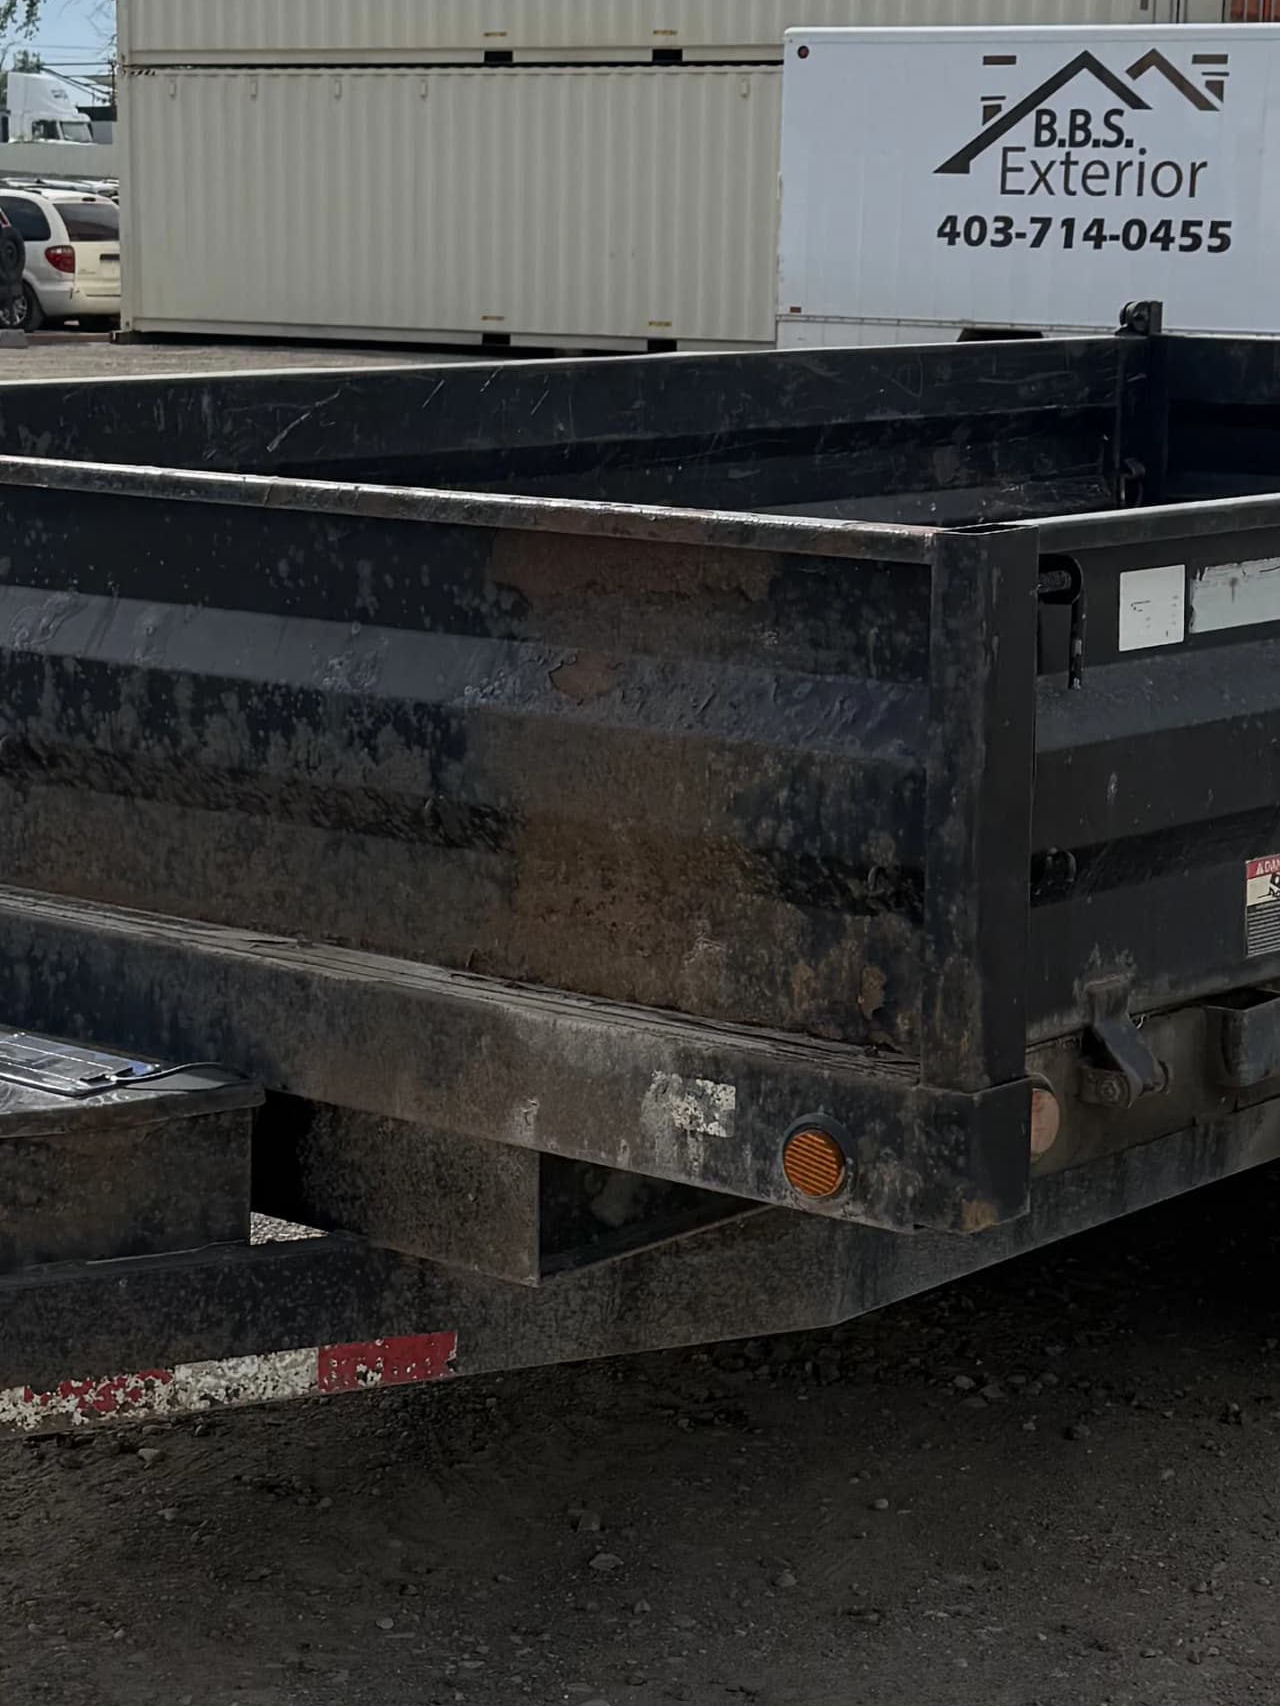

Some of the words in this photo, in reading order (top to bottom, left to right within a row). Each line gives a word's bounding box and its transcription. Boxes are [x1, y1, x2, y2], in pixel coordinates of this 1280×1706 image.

[1033, 108, 1134, 148] B.B.S.
[999, 146, 1208, 198] Exterior
[936, 214, 1233, 254] 403-714-0455
